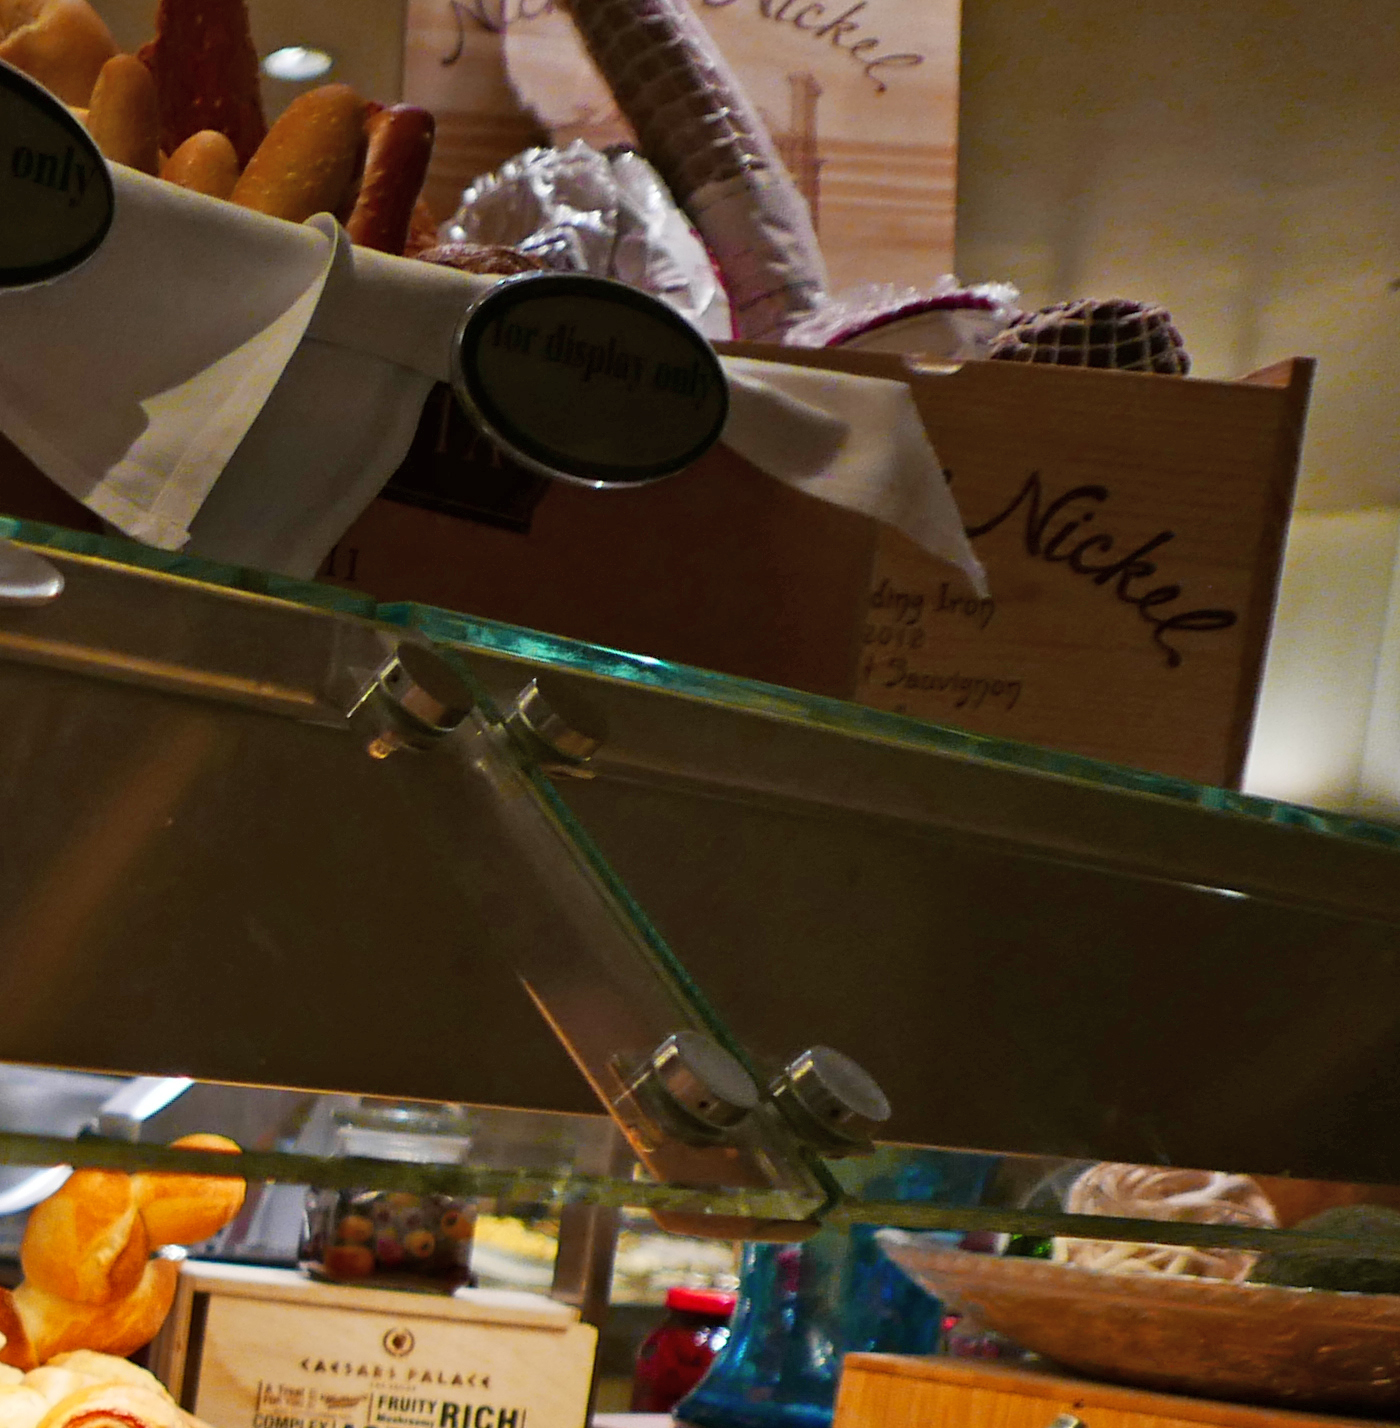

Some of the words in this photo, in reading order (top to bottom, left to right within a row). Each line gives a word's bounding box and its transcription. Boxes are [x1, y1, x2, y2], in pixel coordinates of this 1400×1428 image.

[759, 0, 924, 93] ickel
[11, 144, 94, 207] only
[546, 322, 646, 392] display
[967, 468, 1238, 669] Nickel
[301, 1357, 396, 1379] CAESARS
[407, 1366, 491, 1390] PALACE
[378, 1395, 437, 1415] FRUITY
